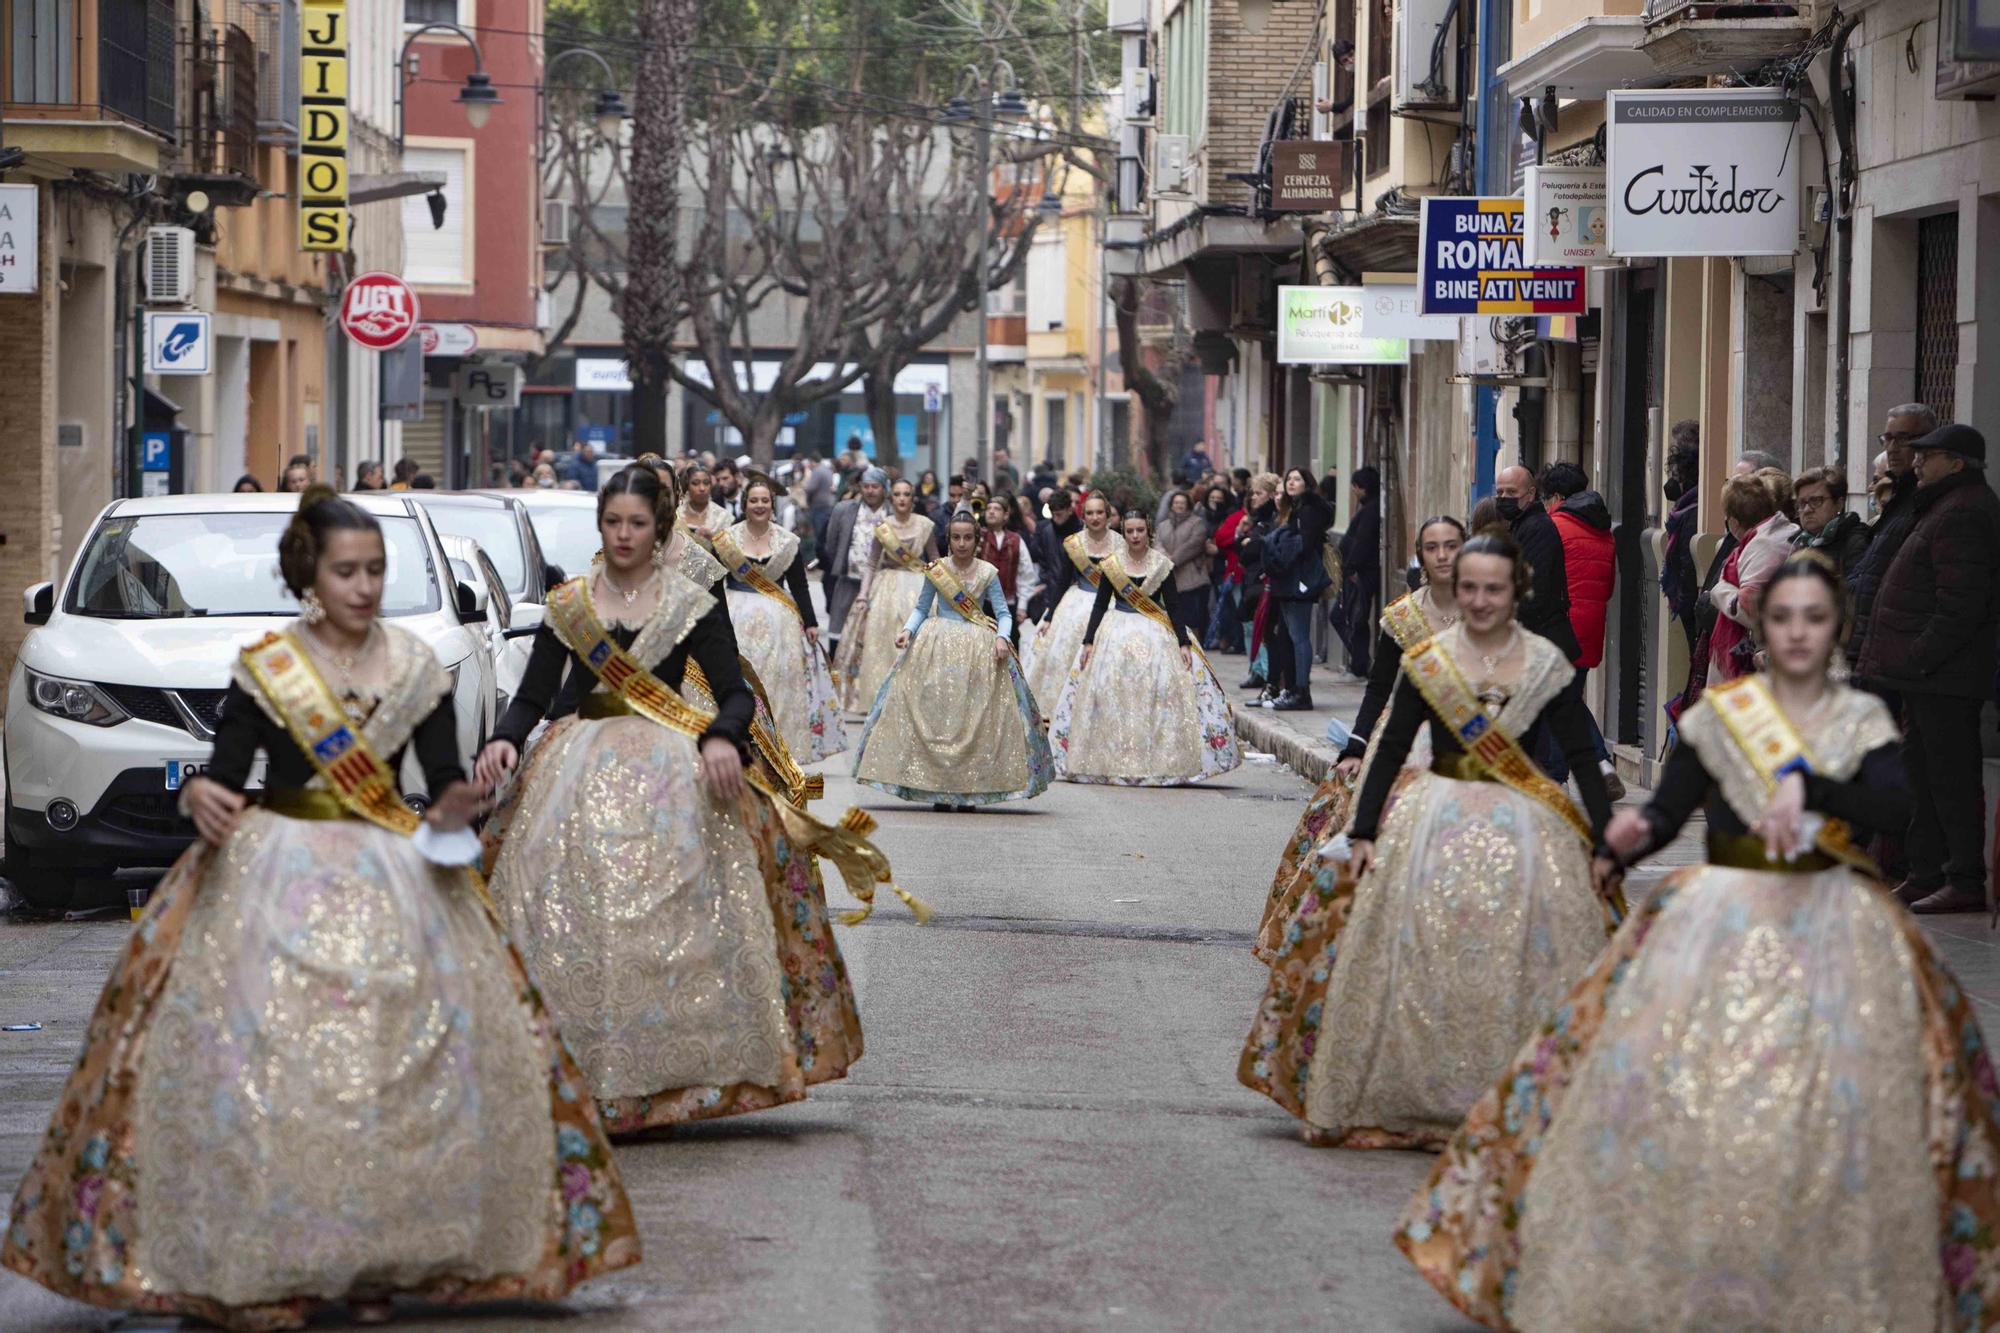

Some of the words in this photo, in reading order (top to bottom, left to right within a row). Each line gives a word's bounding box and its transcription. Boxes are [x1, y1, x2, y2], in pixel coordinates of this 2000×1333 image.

[1627, 106, 1675, 118] CALIDAD
[1678, 106, 1692, 117] EN
[1695, 105, 1784, 117] COMPLEMENTOS
[1284, 174, 1331, 187] CERVEZAS
[1281, 187, 1334, 199] ALHAMBRA
[1455, 214, 1506, 233] BUNA
[1563, 248, 1596, 257] UNISEX
[1435, 280, 1479, 299] BINE
[1484, 280, 1514, 299] ATI
[1519, 280, 1576, 299] VENIT
[350, 285, 405, 316] UGT
[147, 439, 165, 462] P
